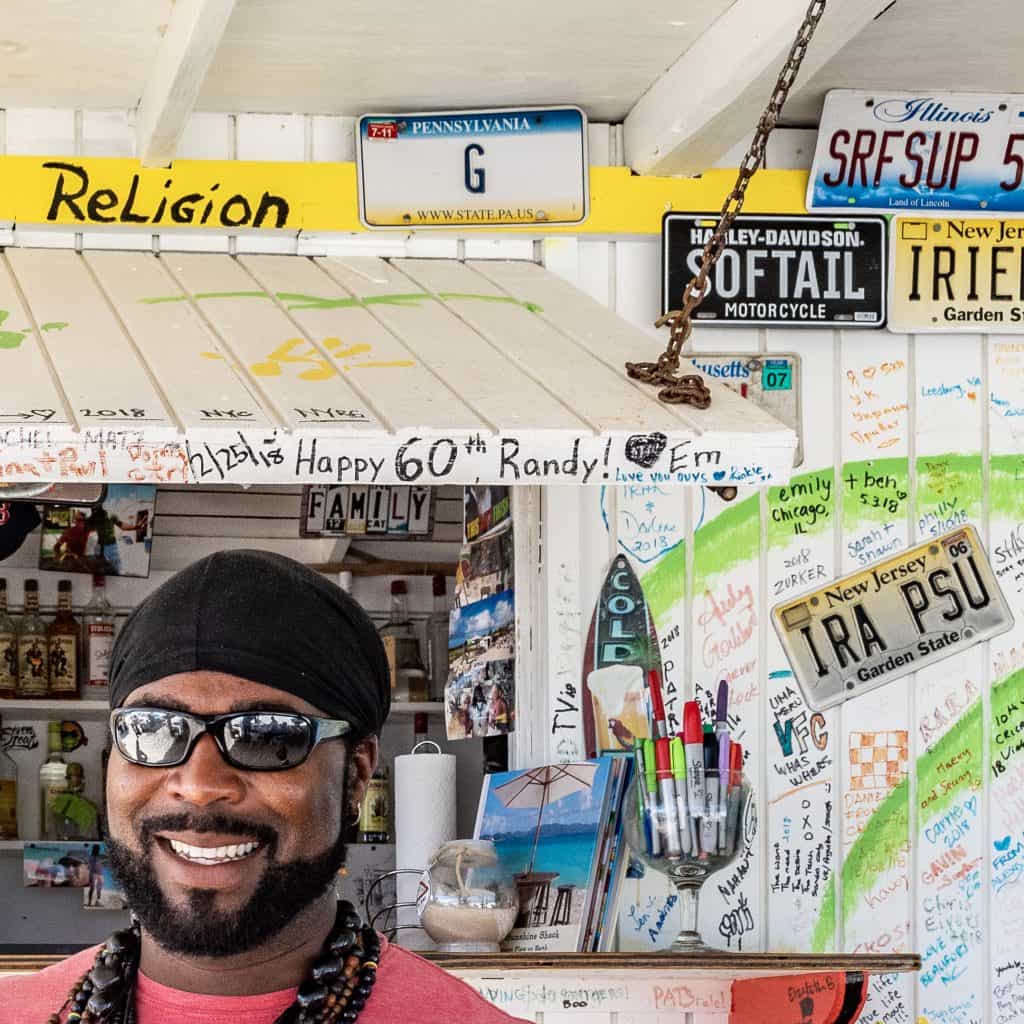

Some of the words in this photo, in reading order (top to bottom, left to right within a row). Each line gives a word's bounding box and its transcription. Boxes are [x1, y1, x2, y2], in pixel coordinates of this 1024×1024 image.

[413, 117, 531, 135] PENNSYLVANIA
[874, 98, 994, 124] Illinois
[370, 126, 393, 138] 7-11
[464, 143, 486, 194] G
[823, 129, 980, 190] SRFSUP
[416, 207, 535, 222] WWW.STATE.PA.US
[888, 198, 912, 208] Land
[913, 198, 920, 207] of
[920, 199, 950, 208] Lincoln
[947, 220, 982, 239] New
[685, 250, 865, 300] SOFTAIL
[908, 246, 1024, 301] IRIE
[725, 303, 827, 319] MOTORCYCLE
[943, 307, 1005, 323] Garden
[766, 372, 788, 388] 07
[295, 436, 386, 482] Happy
[394, 431, 487, 482] 60th
[498, 435, 611, 484] Randy!
[669, 441, 721, 474] Em
[778, 476, 831, 503] emily
[863, 470, 898, 491] ben
[308, 490, 427, 521] FAMILY
[771, 502, 830, 526] Chicago,
[793, 522, 808, 535] IL
[823, 577, 870, 609] New
[872, 555, 928, 593] Jersey
[948, 541, 969, 559] 06
[602, 571, 636, 663] COLD
[799, 602, 888, 678] IRA
[899, 555, 990, 635] PSU
[856, 650, 915, 683] Garden
[917, 630, 961, 657] State
